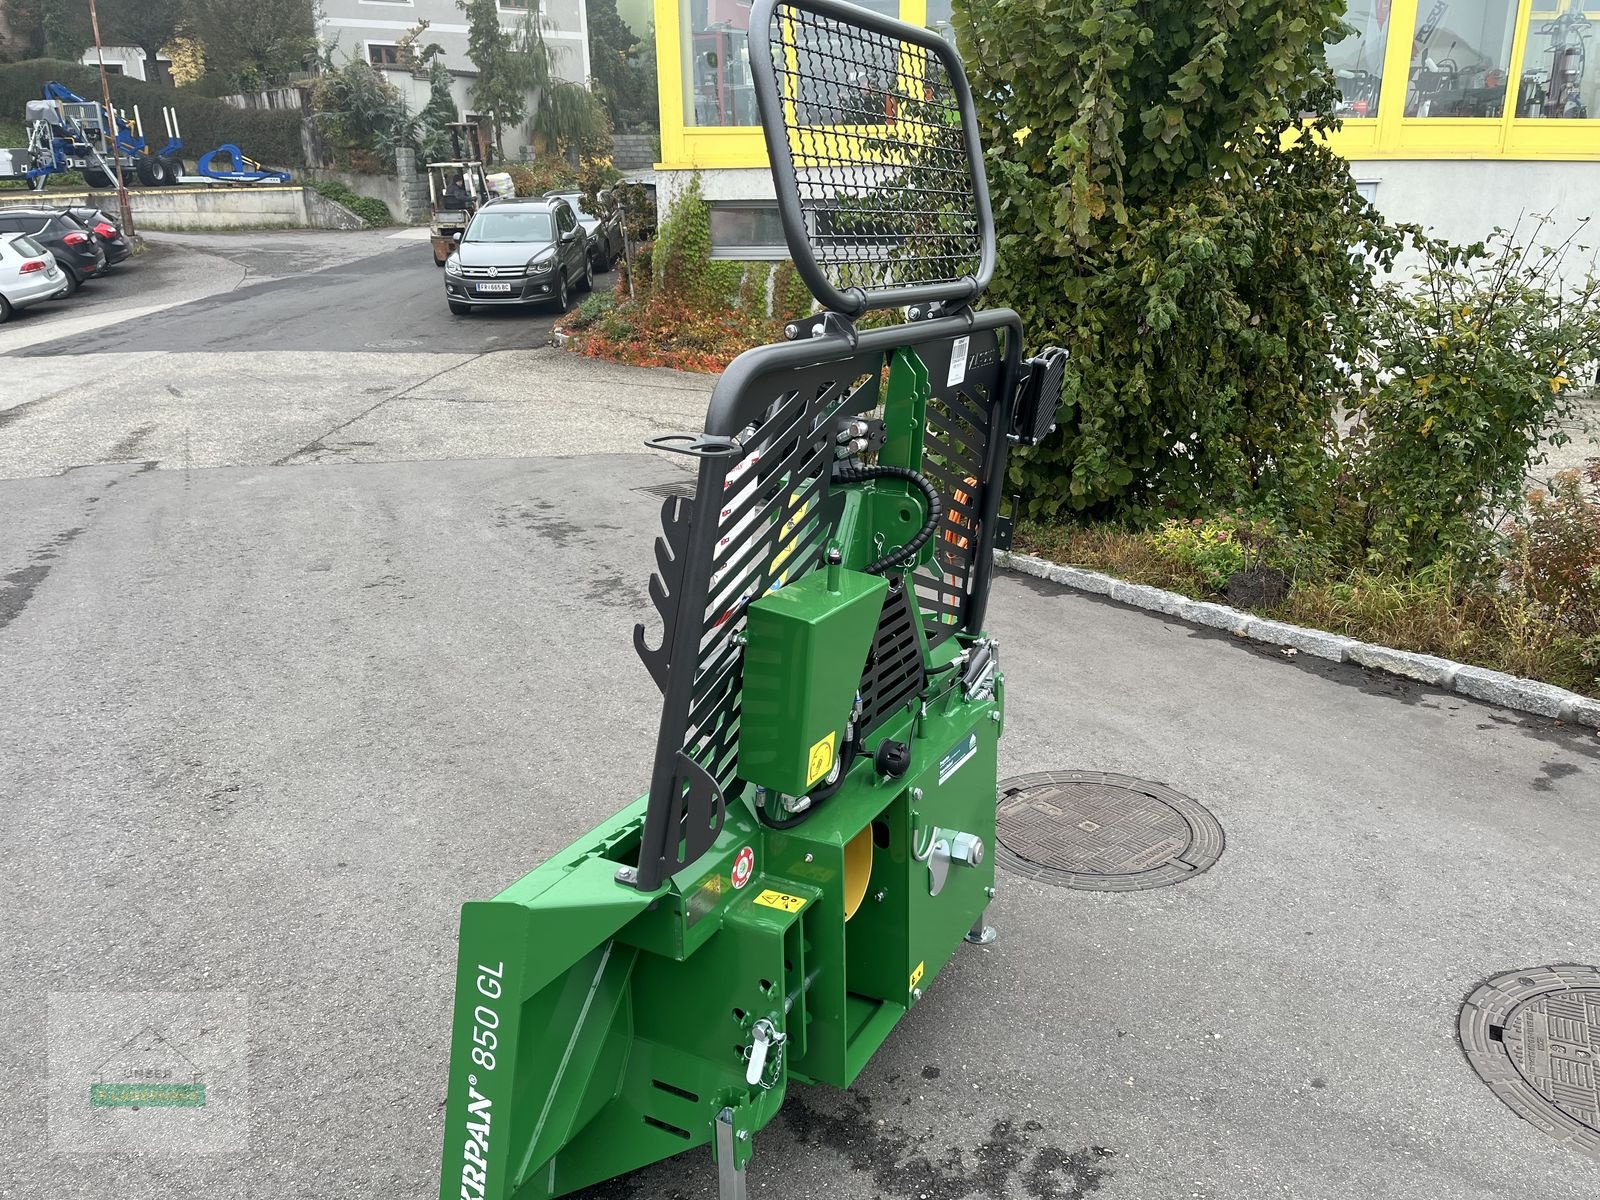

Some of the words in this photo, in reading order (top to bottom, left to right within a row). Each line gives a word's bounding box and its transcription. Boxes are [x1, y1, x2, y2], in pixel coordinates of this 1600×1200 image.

[1415, 0, 1446, 42] POSCH
[476, 961, 504, 999] GL
[471, 1005, 499, 1071] 850
